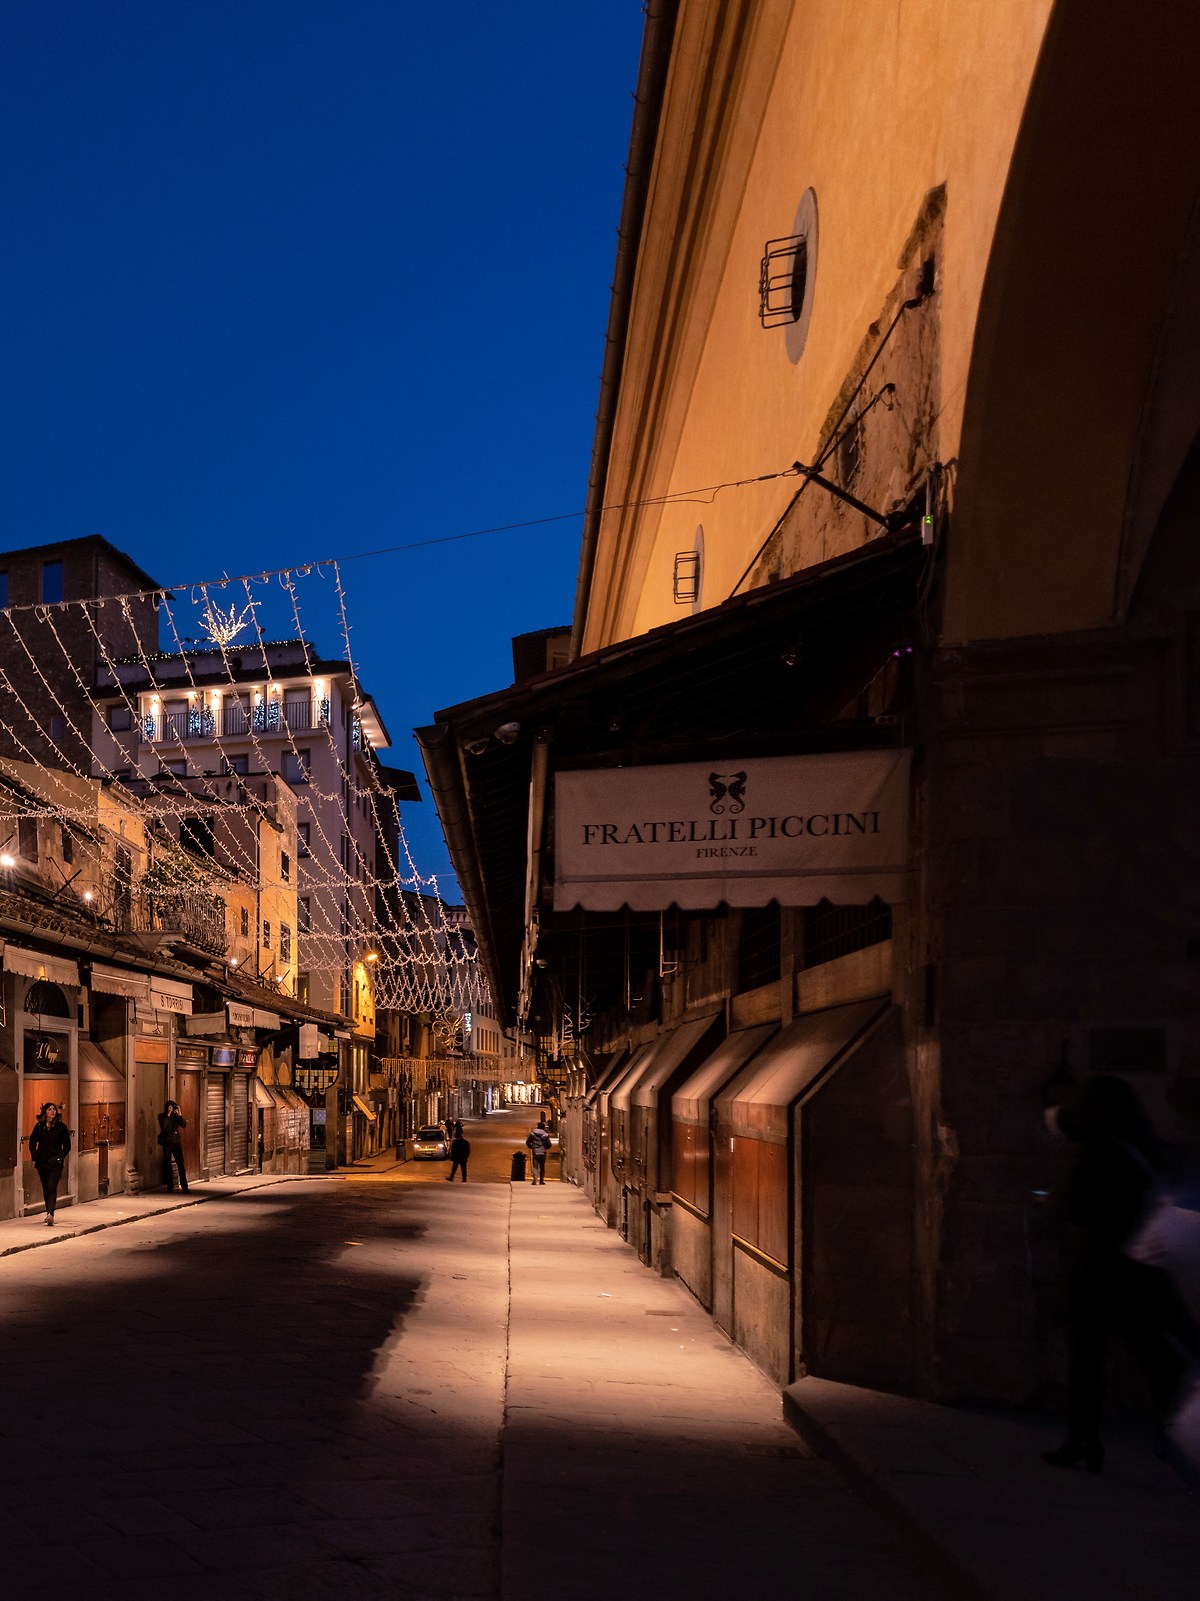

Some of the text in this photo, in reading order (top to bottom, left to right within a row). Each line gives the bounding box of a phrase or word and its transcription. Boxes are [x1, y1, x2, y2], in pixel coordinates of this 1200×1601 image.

[582, 811, 881, 845] FRATELLI PICCINI
[696, 846, 759, 859] FIRENZE
